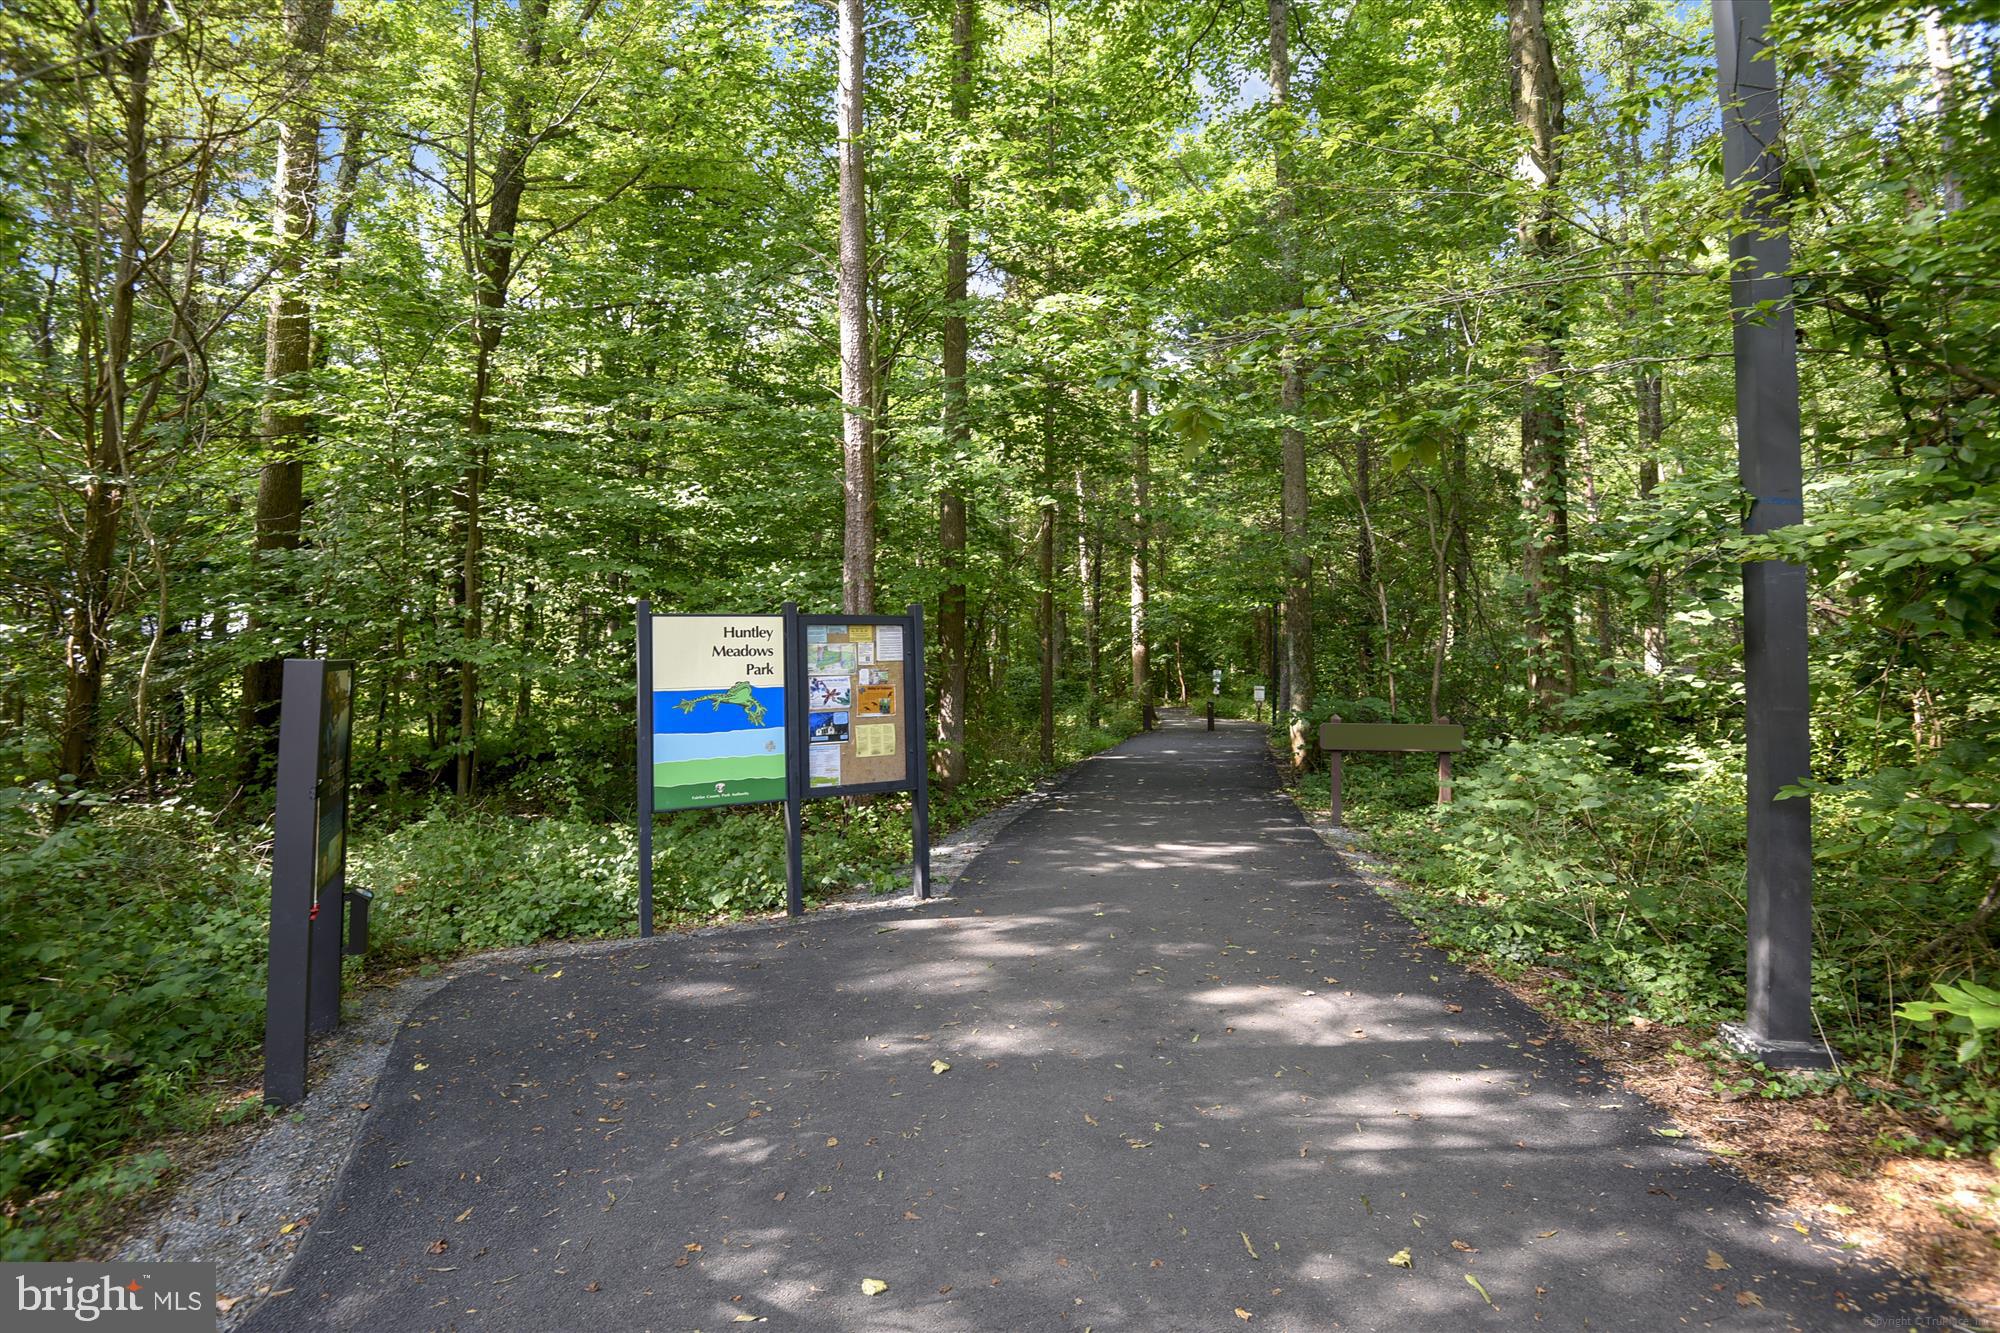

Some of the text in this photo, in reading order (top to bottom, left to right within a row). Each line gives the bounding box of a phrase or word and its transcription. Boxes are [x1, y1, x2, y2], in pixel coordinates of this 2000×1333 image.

[723, 626, 774, 641] Huntley
[711, 644, 774, 657] Meadows
[746, 662, 774, 675] Park
